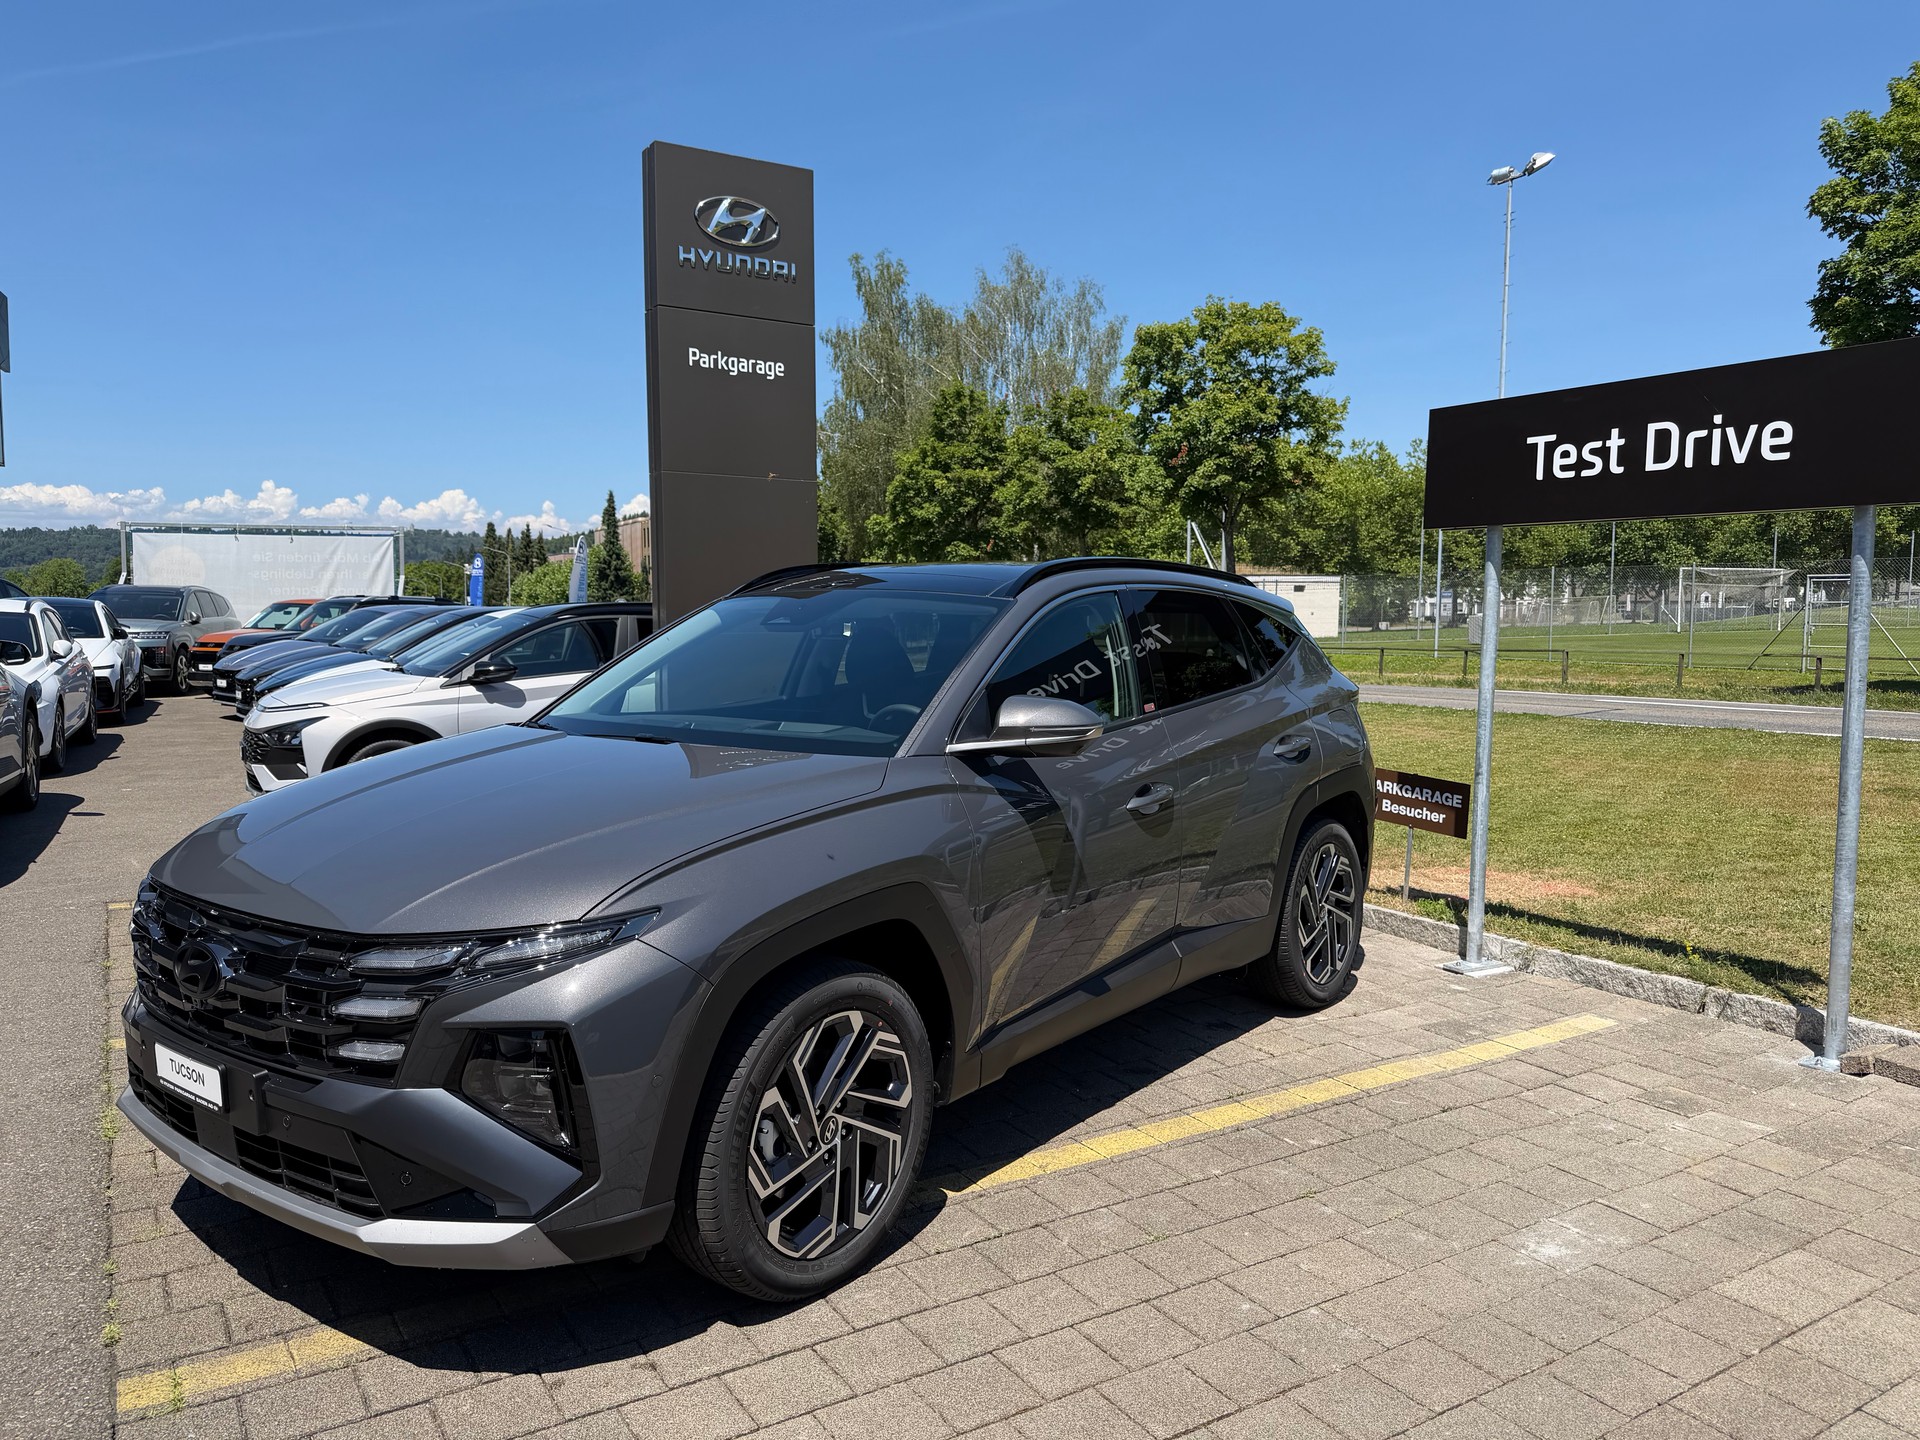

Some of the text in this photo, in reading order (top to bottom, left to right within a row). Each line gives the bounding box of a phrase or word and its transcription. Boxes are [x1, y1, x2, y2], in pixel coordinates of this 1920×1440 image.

[678, 245, 797, 284] HYUNDAI
[688, 347, 785, 380] Parkgarage
[1526, 414, 1793, 481] Test Drive
[1376, 779, 1463, 808] ARKGARAGE
[1382, 799, 1446, 824] Besucher
[169, 1057, 206, 1087] TUCSON
[728, 1081, 757, 1212] MICHELIN
